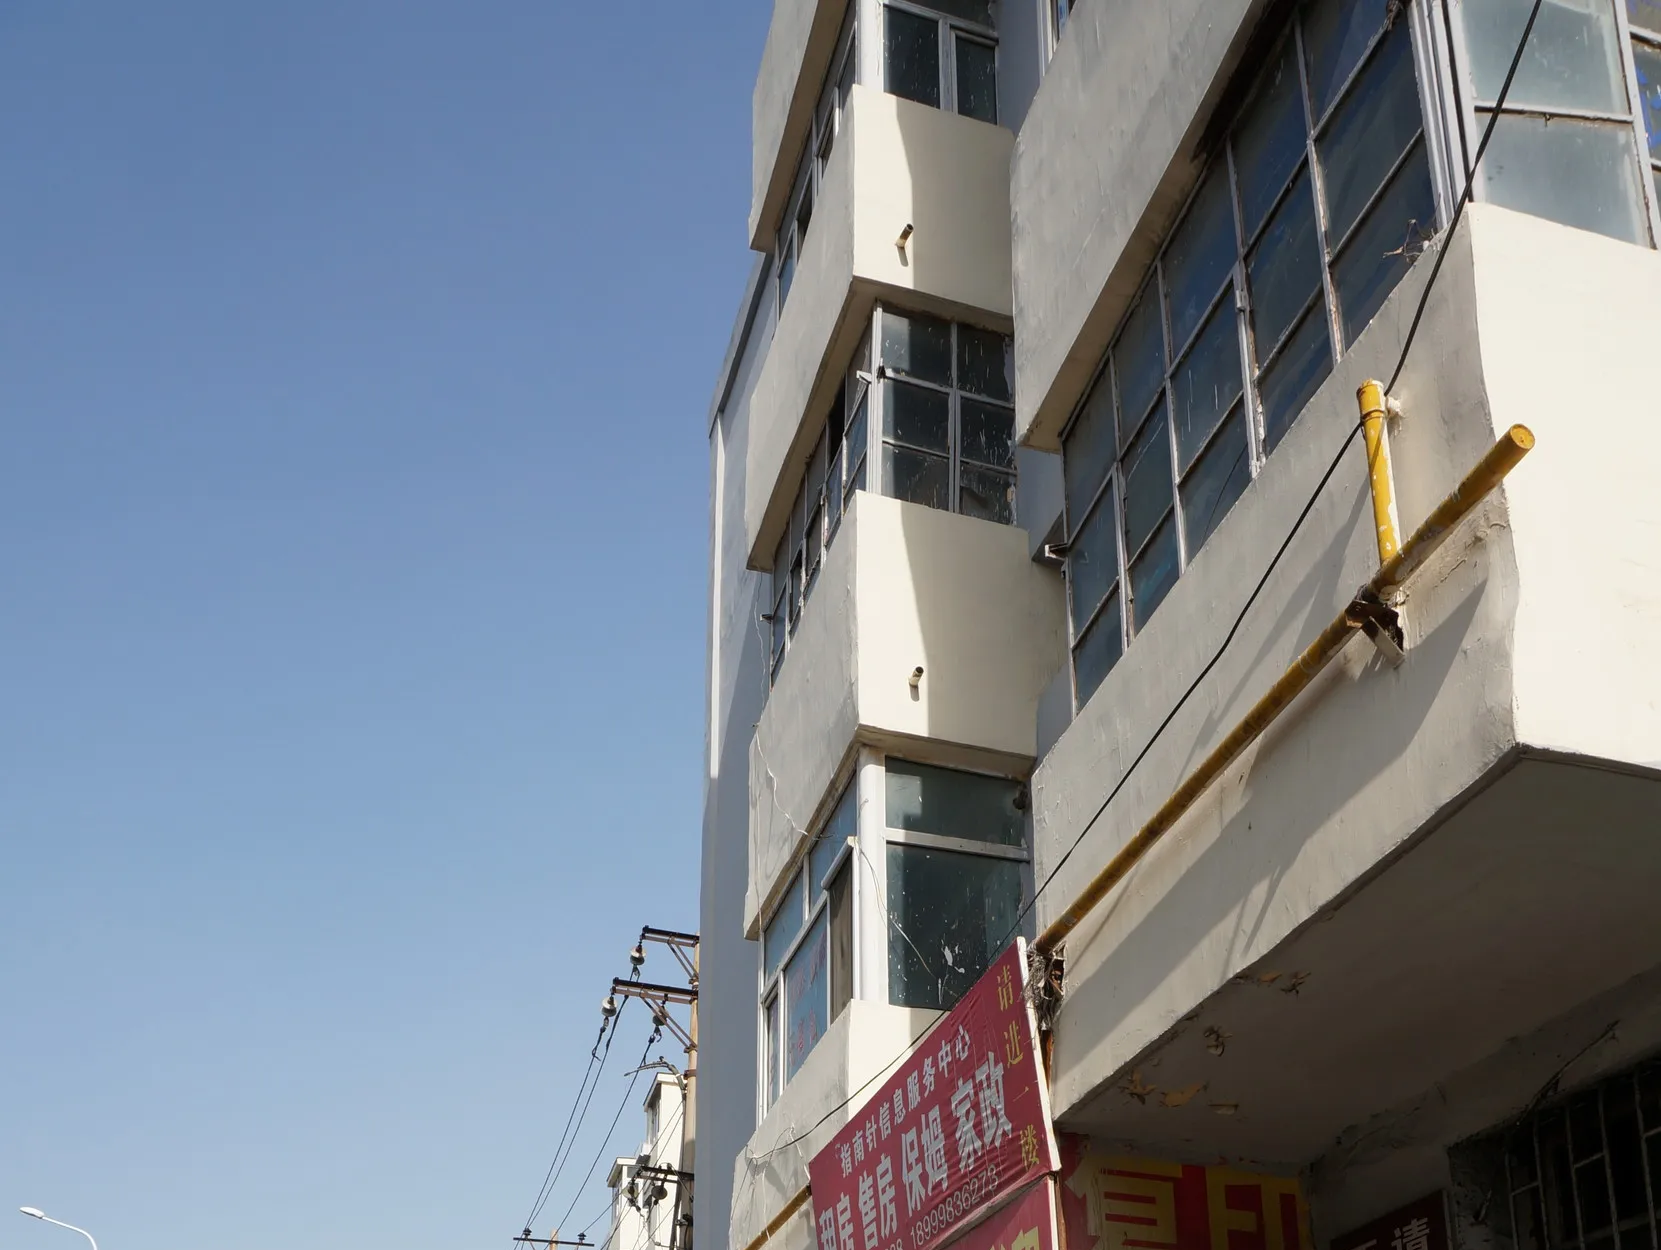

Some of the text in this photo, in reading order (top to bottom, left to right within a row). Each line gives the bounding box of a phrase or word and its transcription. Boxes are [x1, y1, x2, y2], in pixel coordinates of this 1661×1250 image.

[840, 1024, 971, 1179] 指南针信息服务中心
[901, 1104, 949, 1218] 保姆
[950, 1051, 1012, 1174] 家政
[997, 964, 1039, 1172] 请进一楼
[910, 1163, 999, 1249] 18999836273
